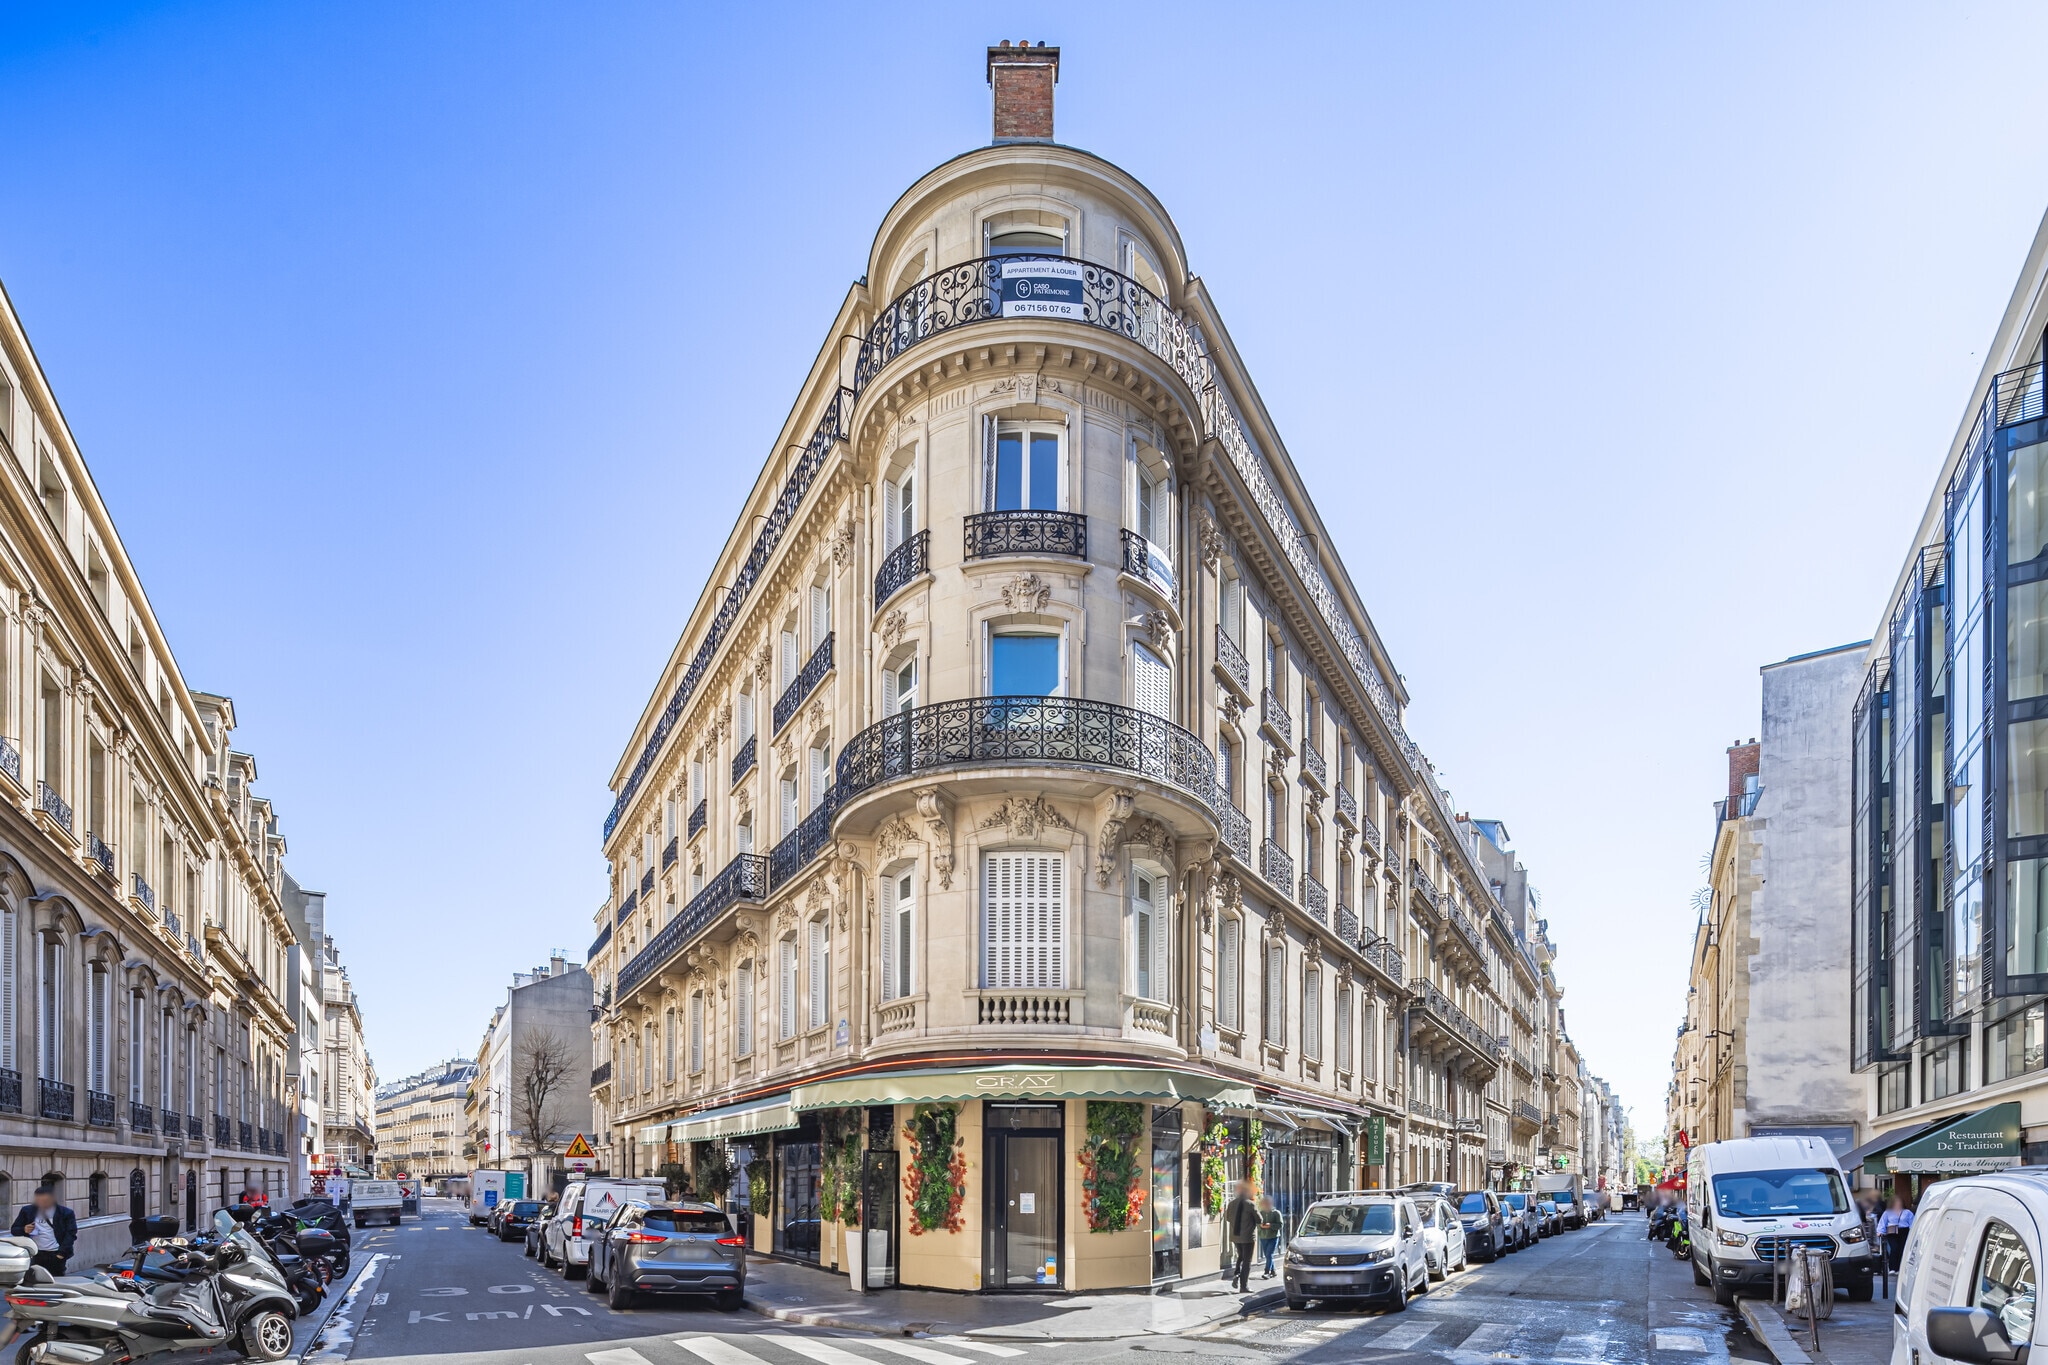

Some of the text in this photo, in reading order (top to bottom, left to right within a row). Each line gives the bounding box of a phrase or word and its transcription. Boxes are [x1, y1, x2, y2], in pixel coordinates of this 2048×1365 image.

[1051, 265, 1056, 273] À
[1056, 267, 1077, 276] LOUER
[1033, 288, 1070, 296] PATRIMOINE
[1014, 304, 1071, 313] 06 71 56 07 62
[975, 1076, 1055, 1087] GRAY
[1372, 1118, 1380, 1155] Marouch
[1948, 1130, 2004, 1140] Restaurant
[1937, 1141, 2004, 1151] De Tradition
[1932, 1160, 2012, 1169] Le Sens Unique
[419, 1284, 536, 1297] 30
